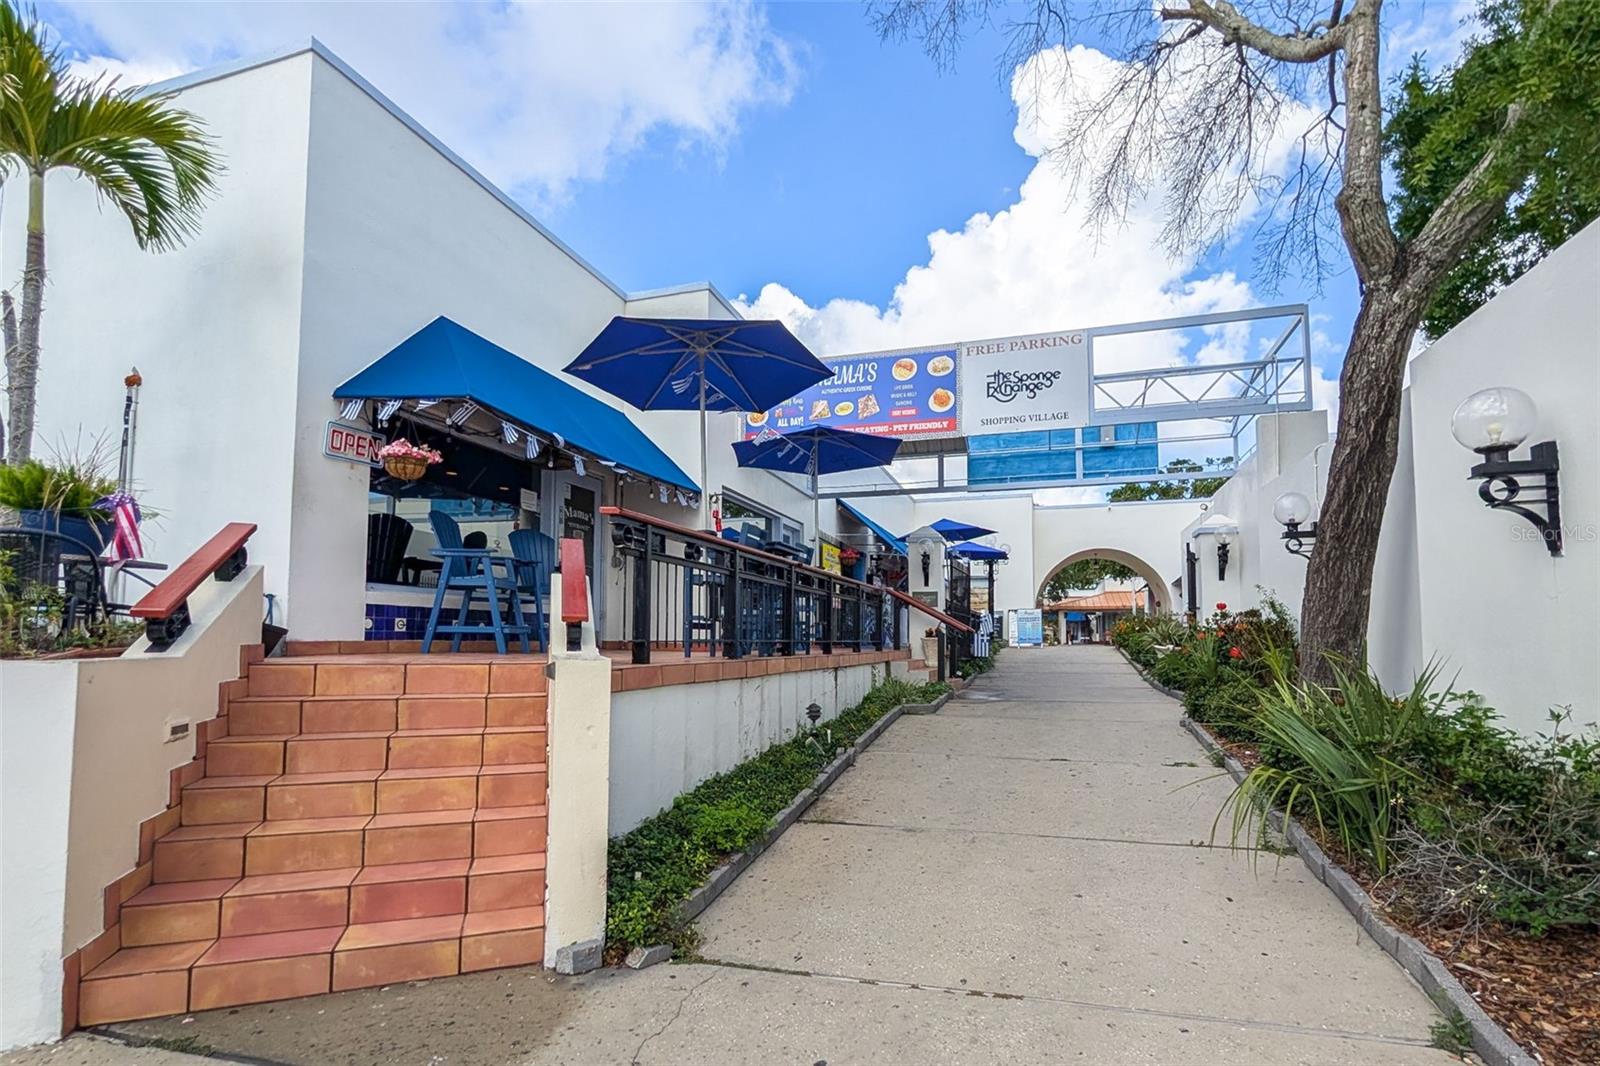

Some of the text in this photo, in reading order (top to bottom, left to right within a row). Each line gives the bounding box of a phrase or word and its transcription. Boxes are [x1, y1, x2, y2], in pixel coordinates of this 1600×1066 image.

[966, 334, 1083, 357] FREE PARKING
[1012, 370, 1061, 389] Sponge
[777, 418, 789, 427] ALL
[980, 412, 1070, 426] SHOPPING VILLAGE
[854, 425, 889, 434] SEATING
[892, 423, 908, 431] PET
[908, 421, 949, 430] FRIENDLY
[330, 427, 382, 462] OPEN
